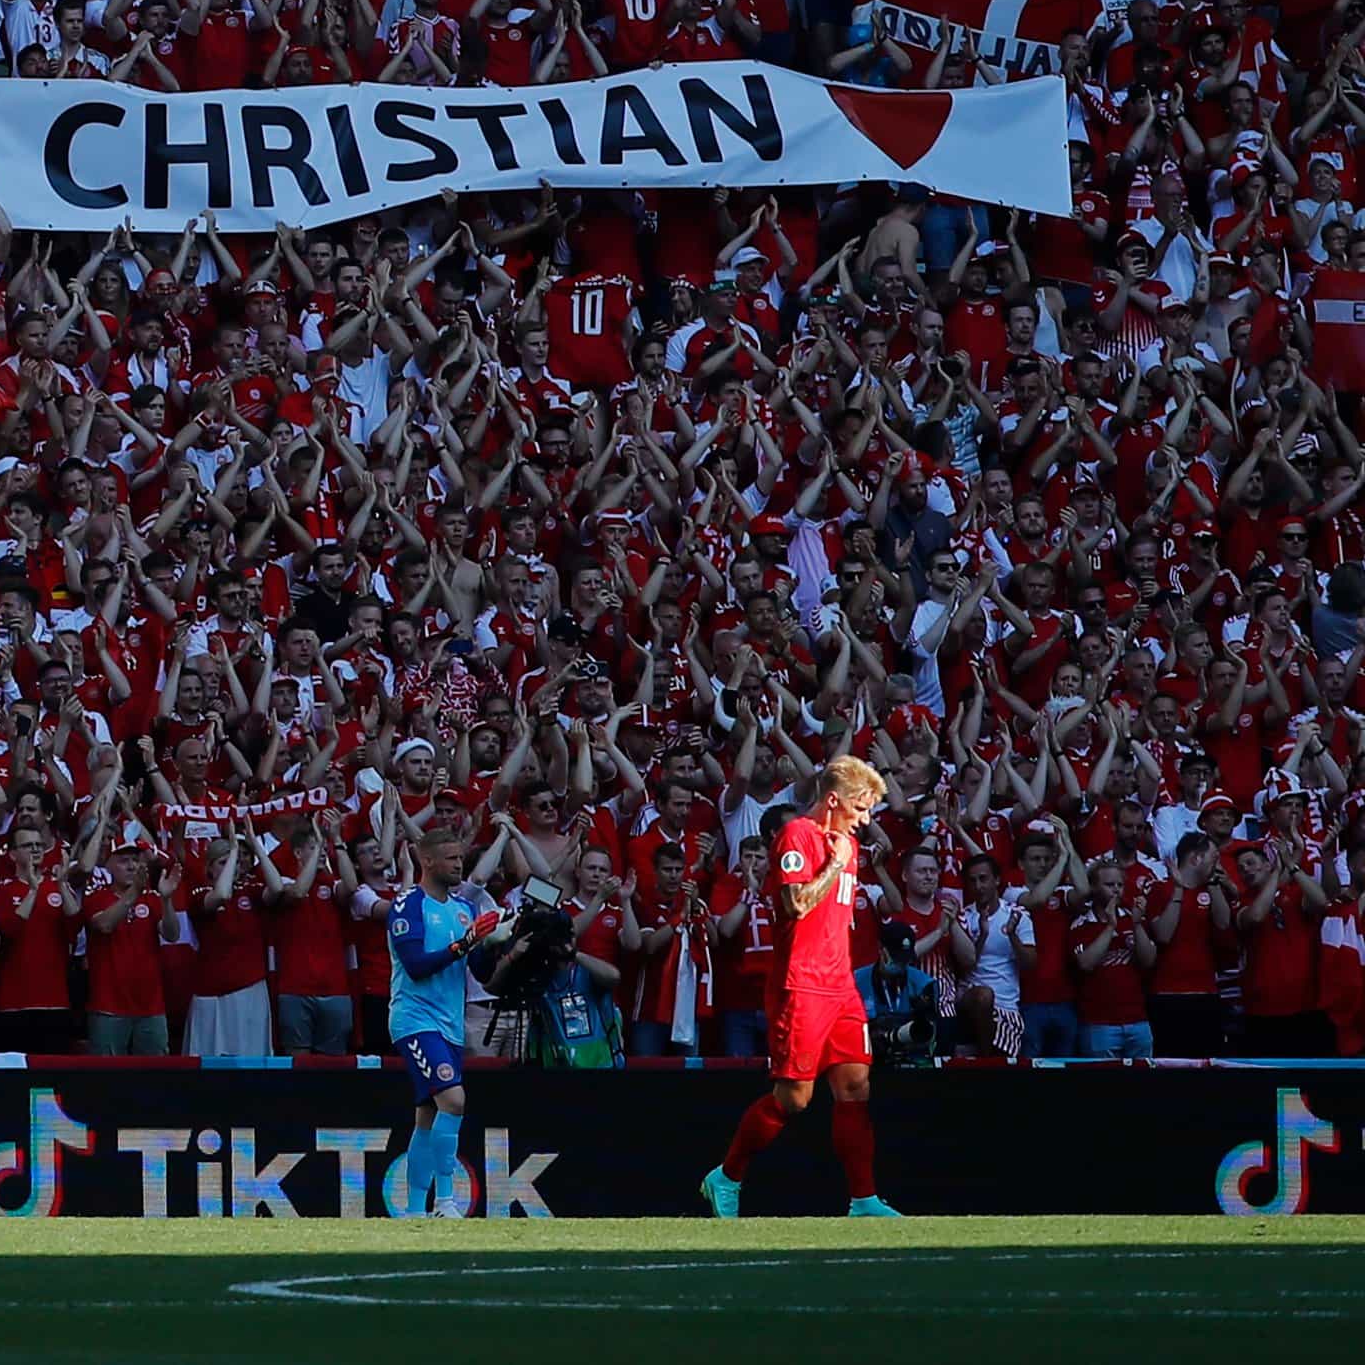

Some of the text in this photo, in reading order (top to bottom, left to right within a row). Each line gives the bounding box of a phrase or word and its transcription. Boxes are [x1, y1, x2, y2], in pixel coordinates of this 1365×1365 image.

[44, 73, 783, 209] CHRISTIAN
[571, 288, 605, 336] 10
[117, 1127, 560, 1218] TikTok
